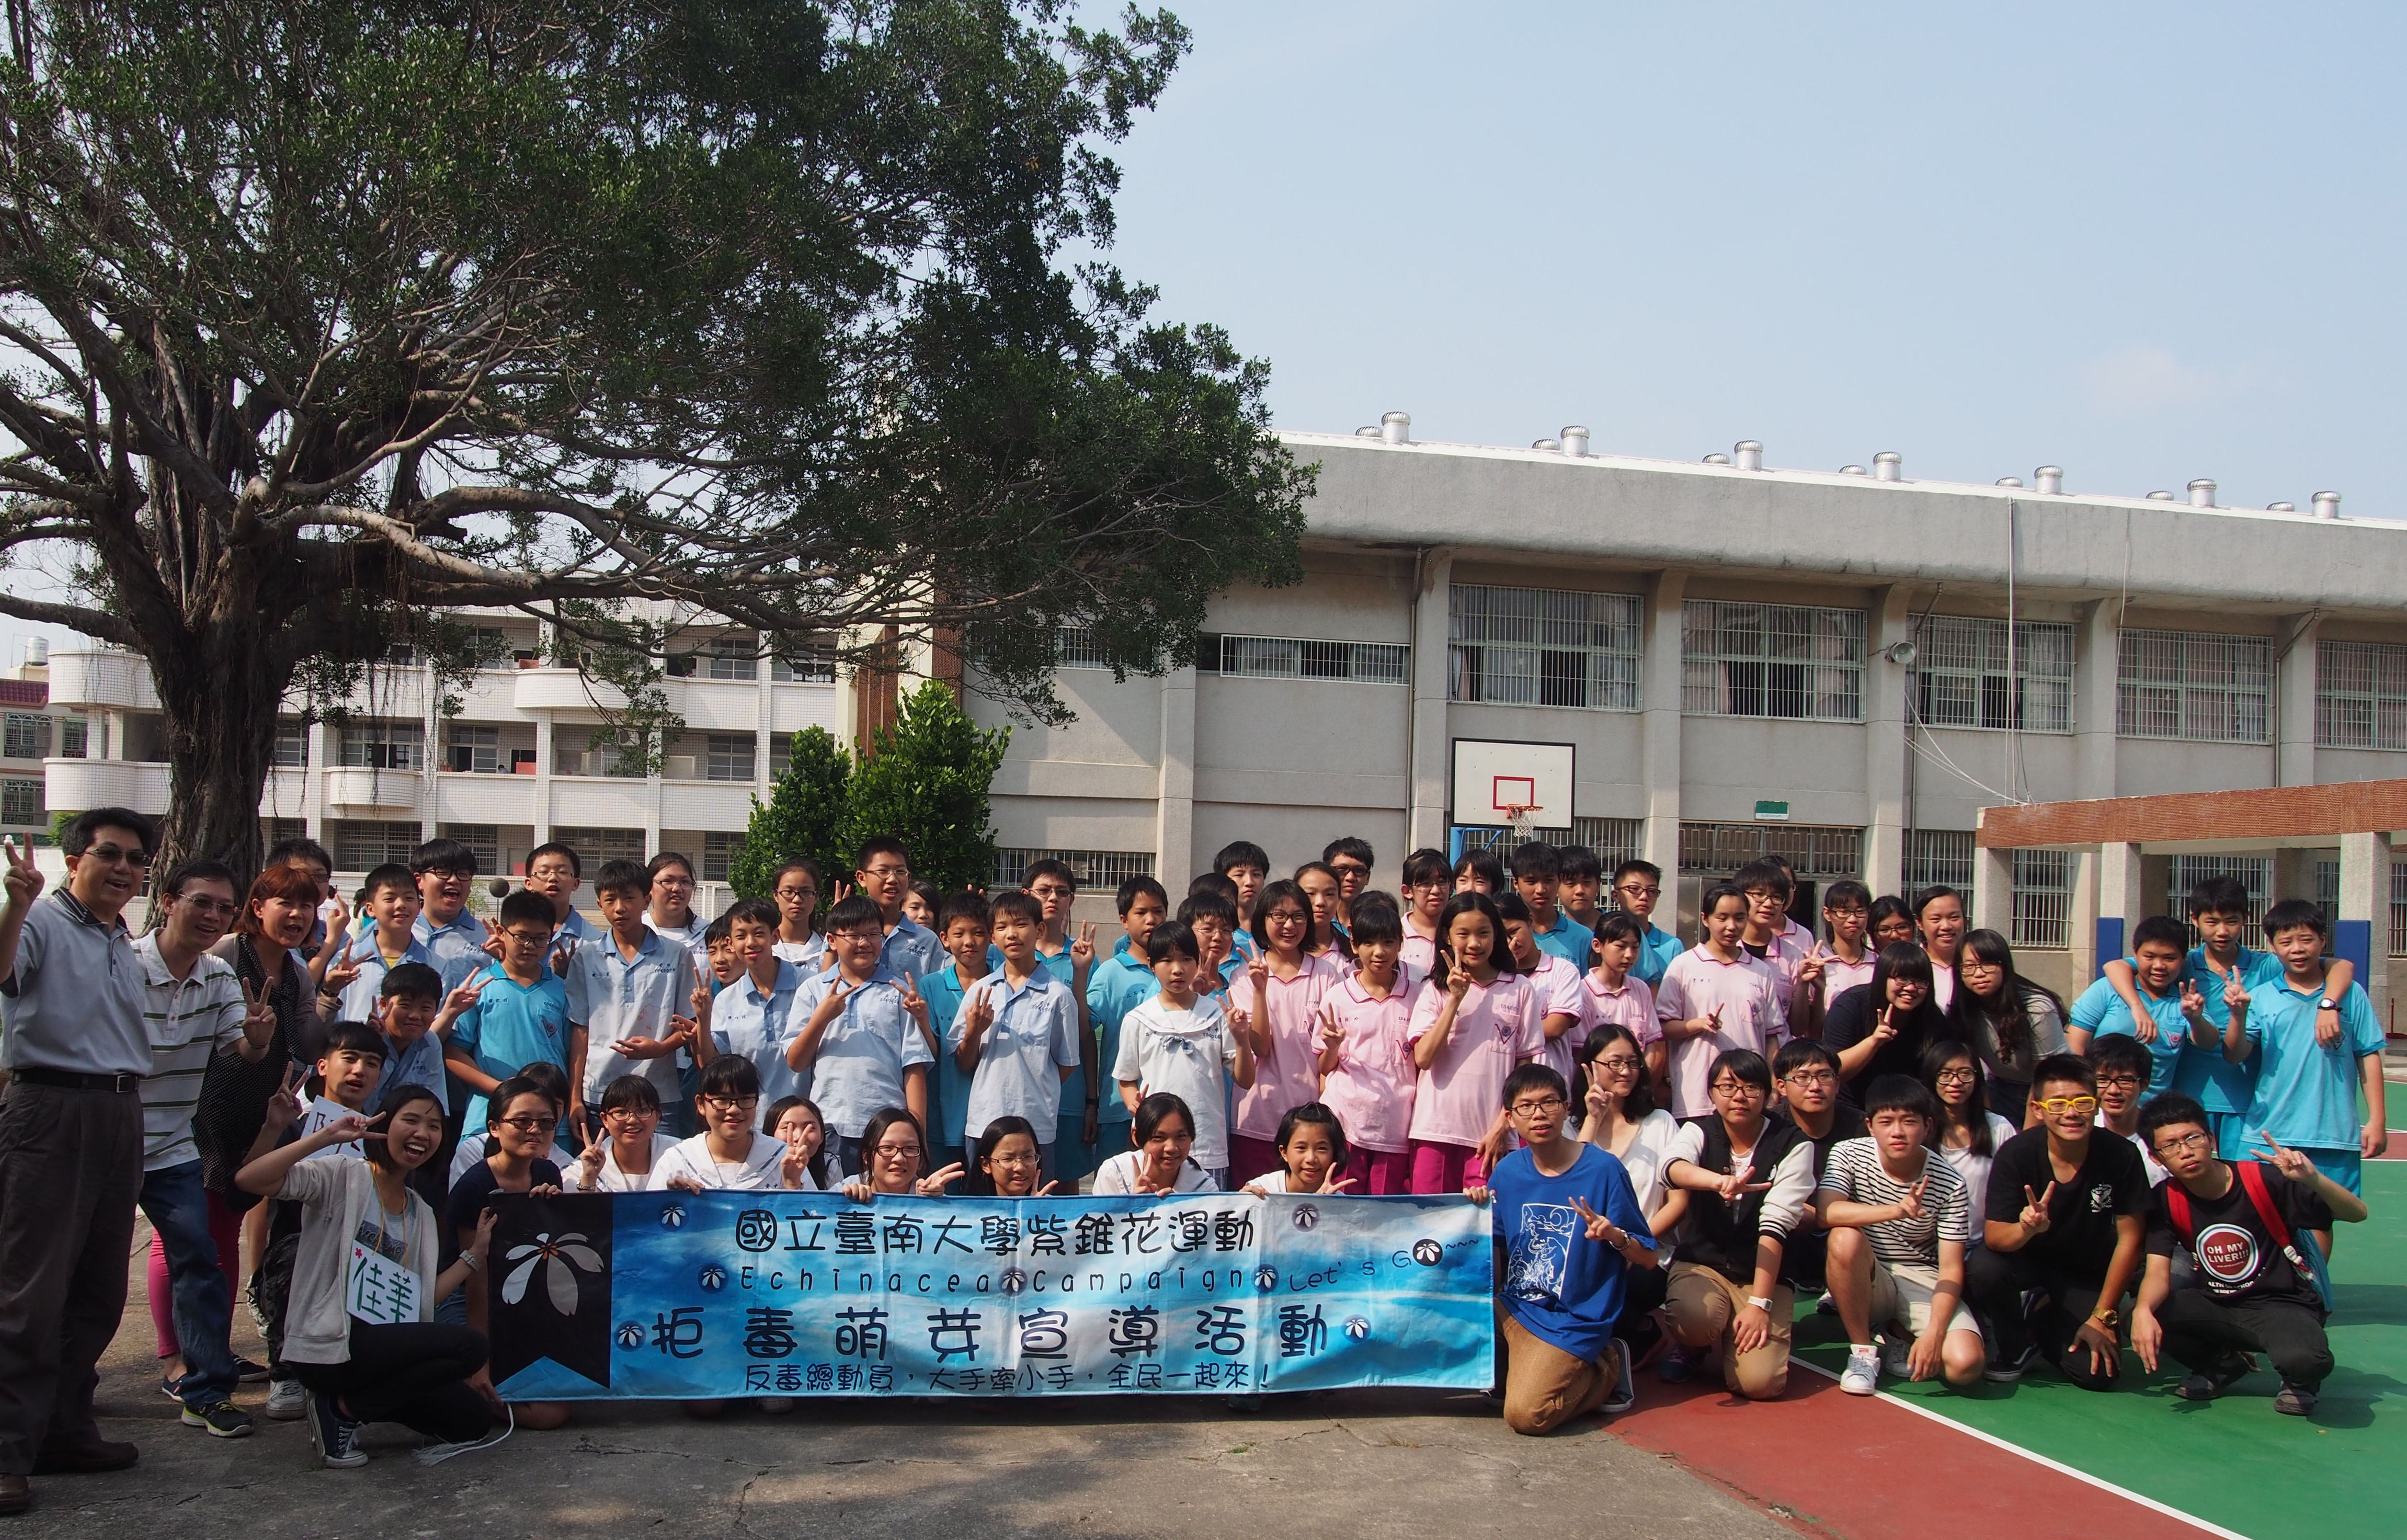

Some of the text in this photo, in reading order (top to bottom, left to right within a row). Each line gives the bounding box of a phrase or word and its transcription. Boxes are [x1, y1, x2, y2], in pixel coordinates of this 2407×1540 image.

[735, 1209, 1254, 1256] 國立臺南大學紫錐花運動
[2207, 1241, 2244, 1254] OH MY
[2207, 1249, 2249, 1263] LIVER!!!
[353, 1257, 413, 1323] 佳華
[740, 1265, 1242, 1293] Echinacea Campaign
[651, 1303, 1328, 1363] 拒毒萌芽宣導活動
